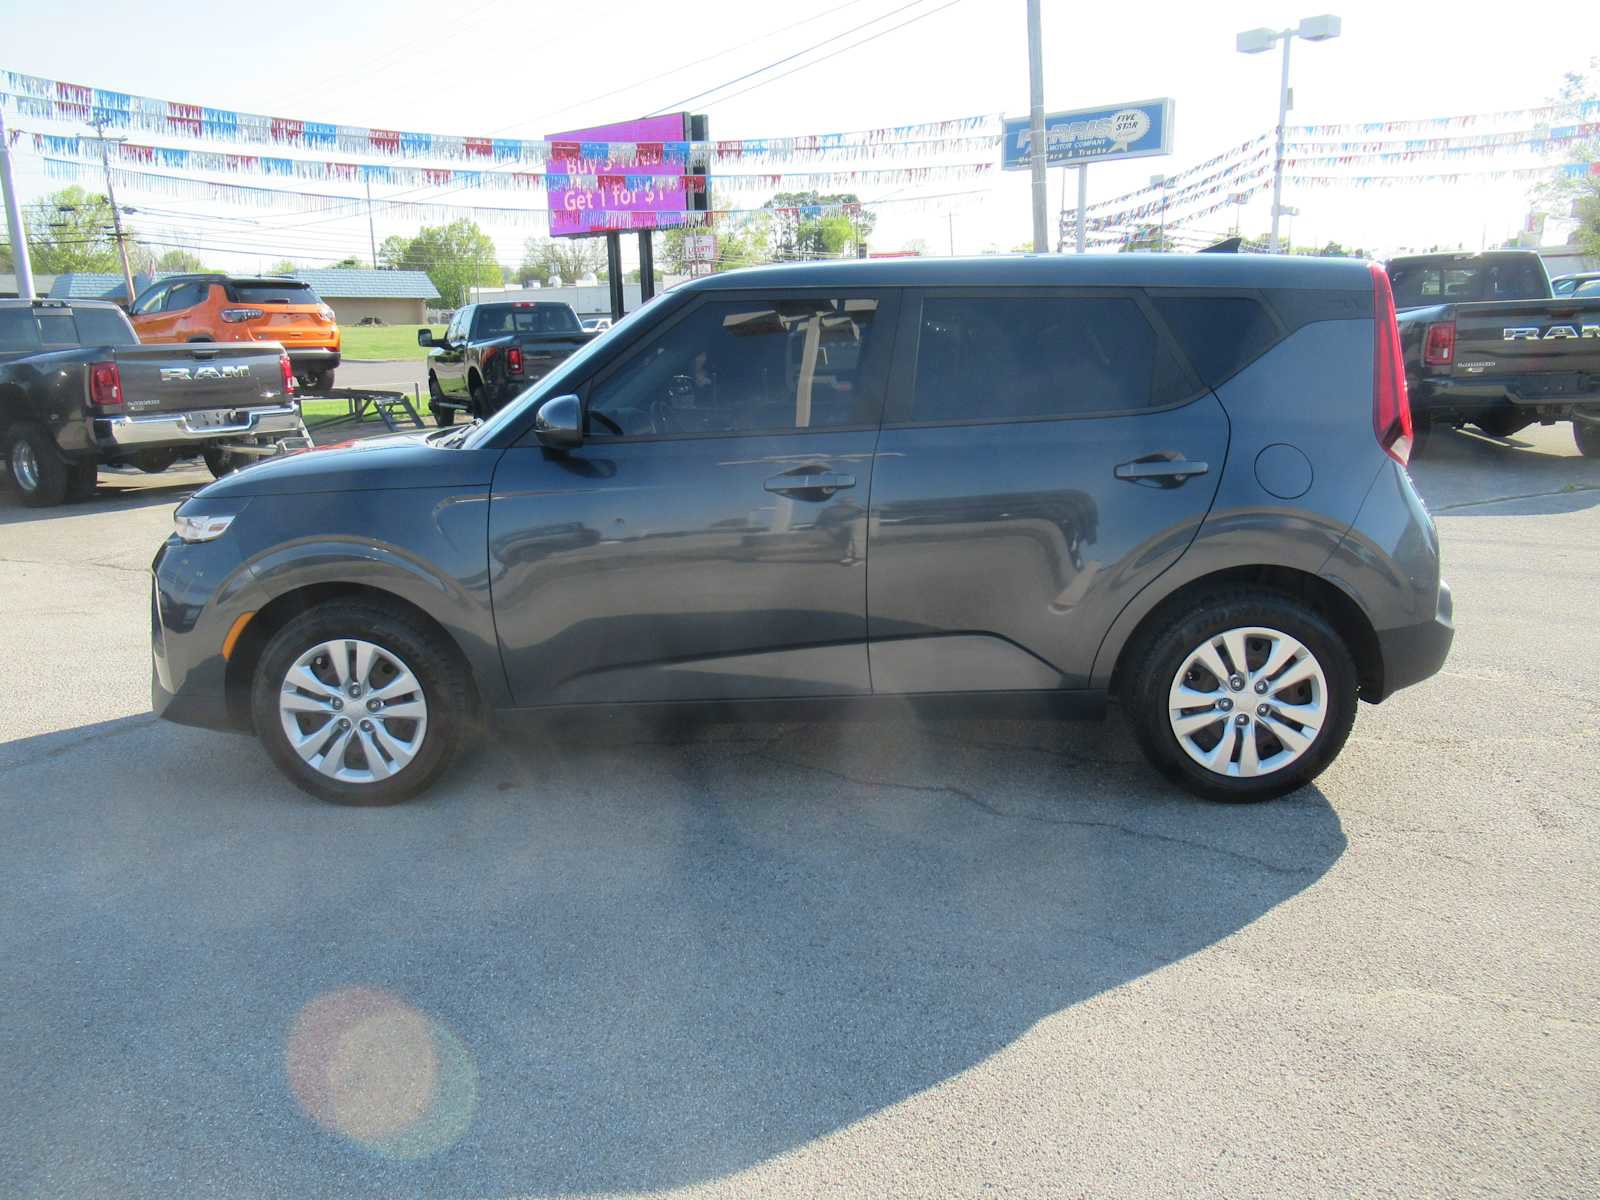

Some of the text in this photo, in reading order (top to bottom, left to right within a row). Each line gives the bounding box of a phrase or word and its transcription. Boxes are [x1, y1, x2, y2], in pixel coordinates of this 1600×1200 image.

[1116, 113, 1137, 122] FIVE
[1116, 121, 1138, 131] STAR
[564, 189, 593, 211] Get
[612, 183, 637, 206] for
[159, 365, 250, 381] RAM
